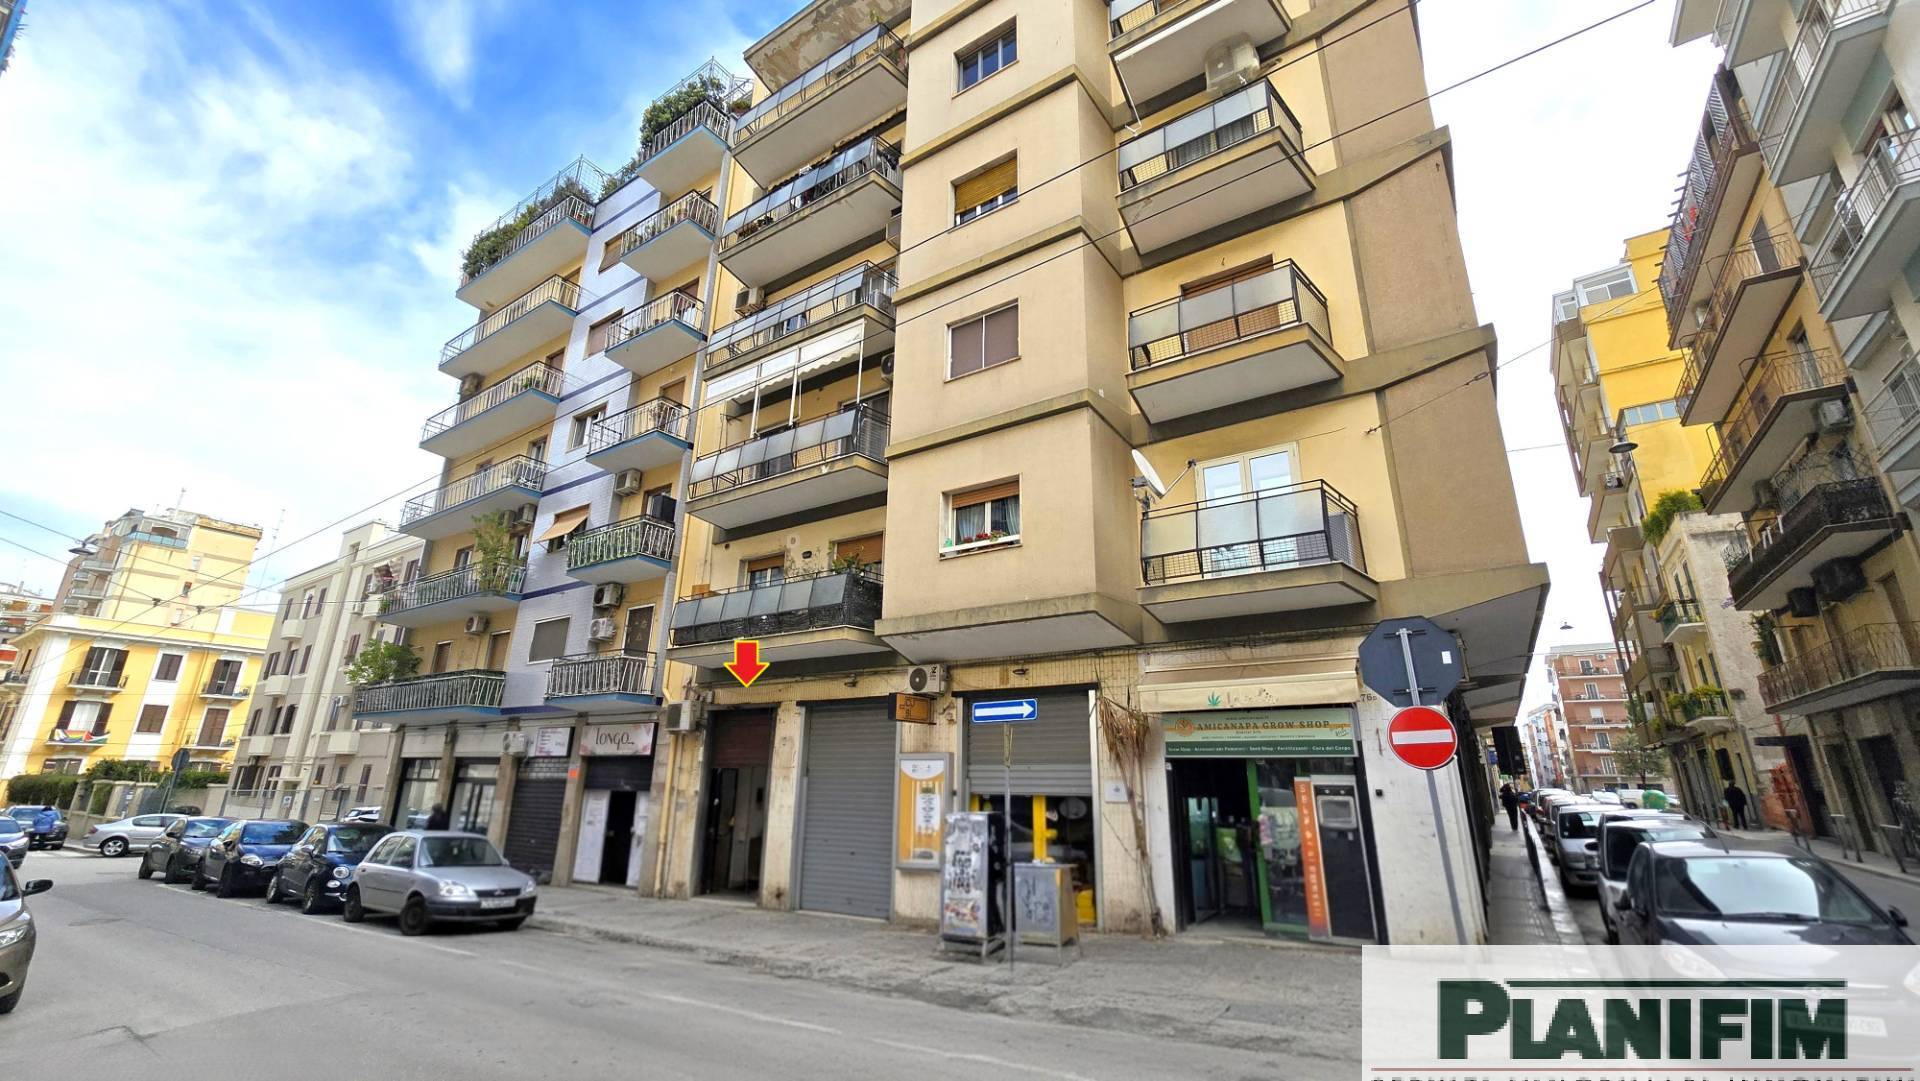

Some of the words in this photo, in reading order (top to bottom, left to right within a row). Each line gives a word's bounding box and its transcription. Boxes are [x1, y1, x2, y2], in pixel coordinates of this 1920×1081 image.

[1197, 721, 1258, 731] AMICANAPA
[1262, 721, 1295, 730] GROW
[1299, 720, 1330, 729] SHOP
